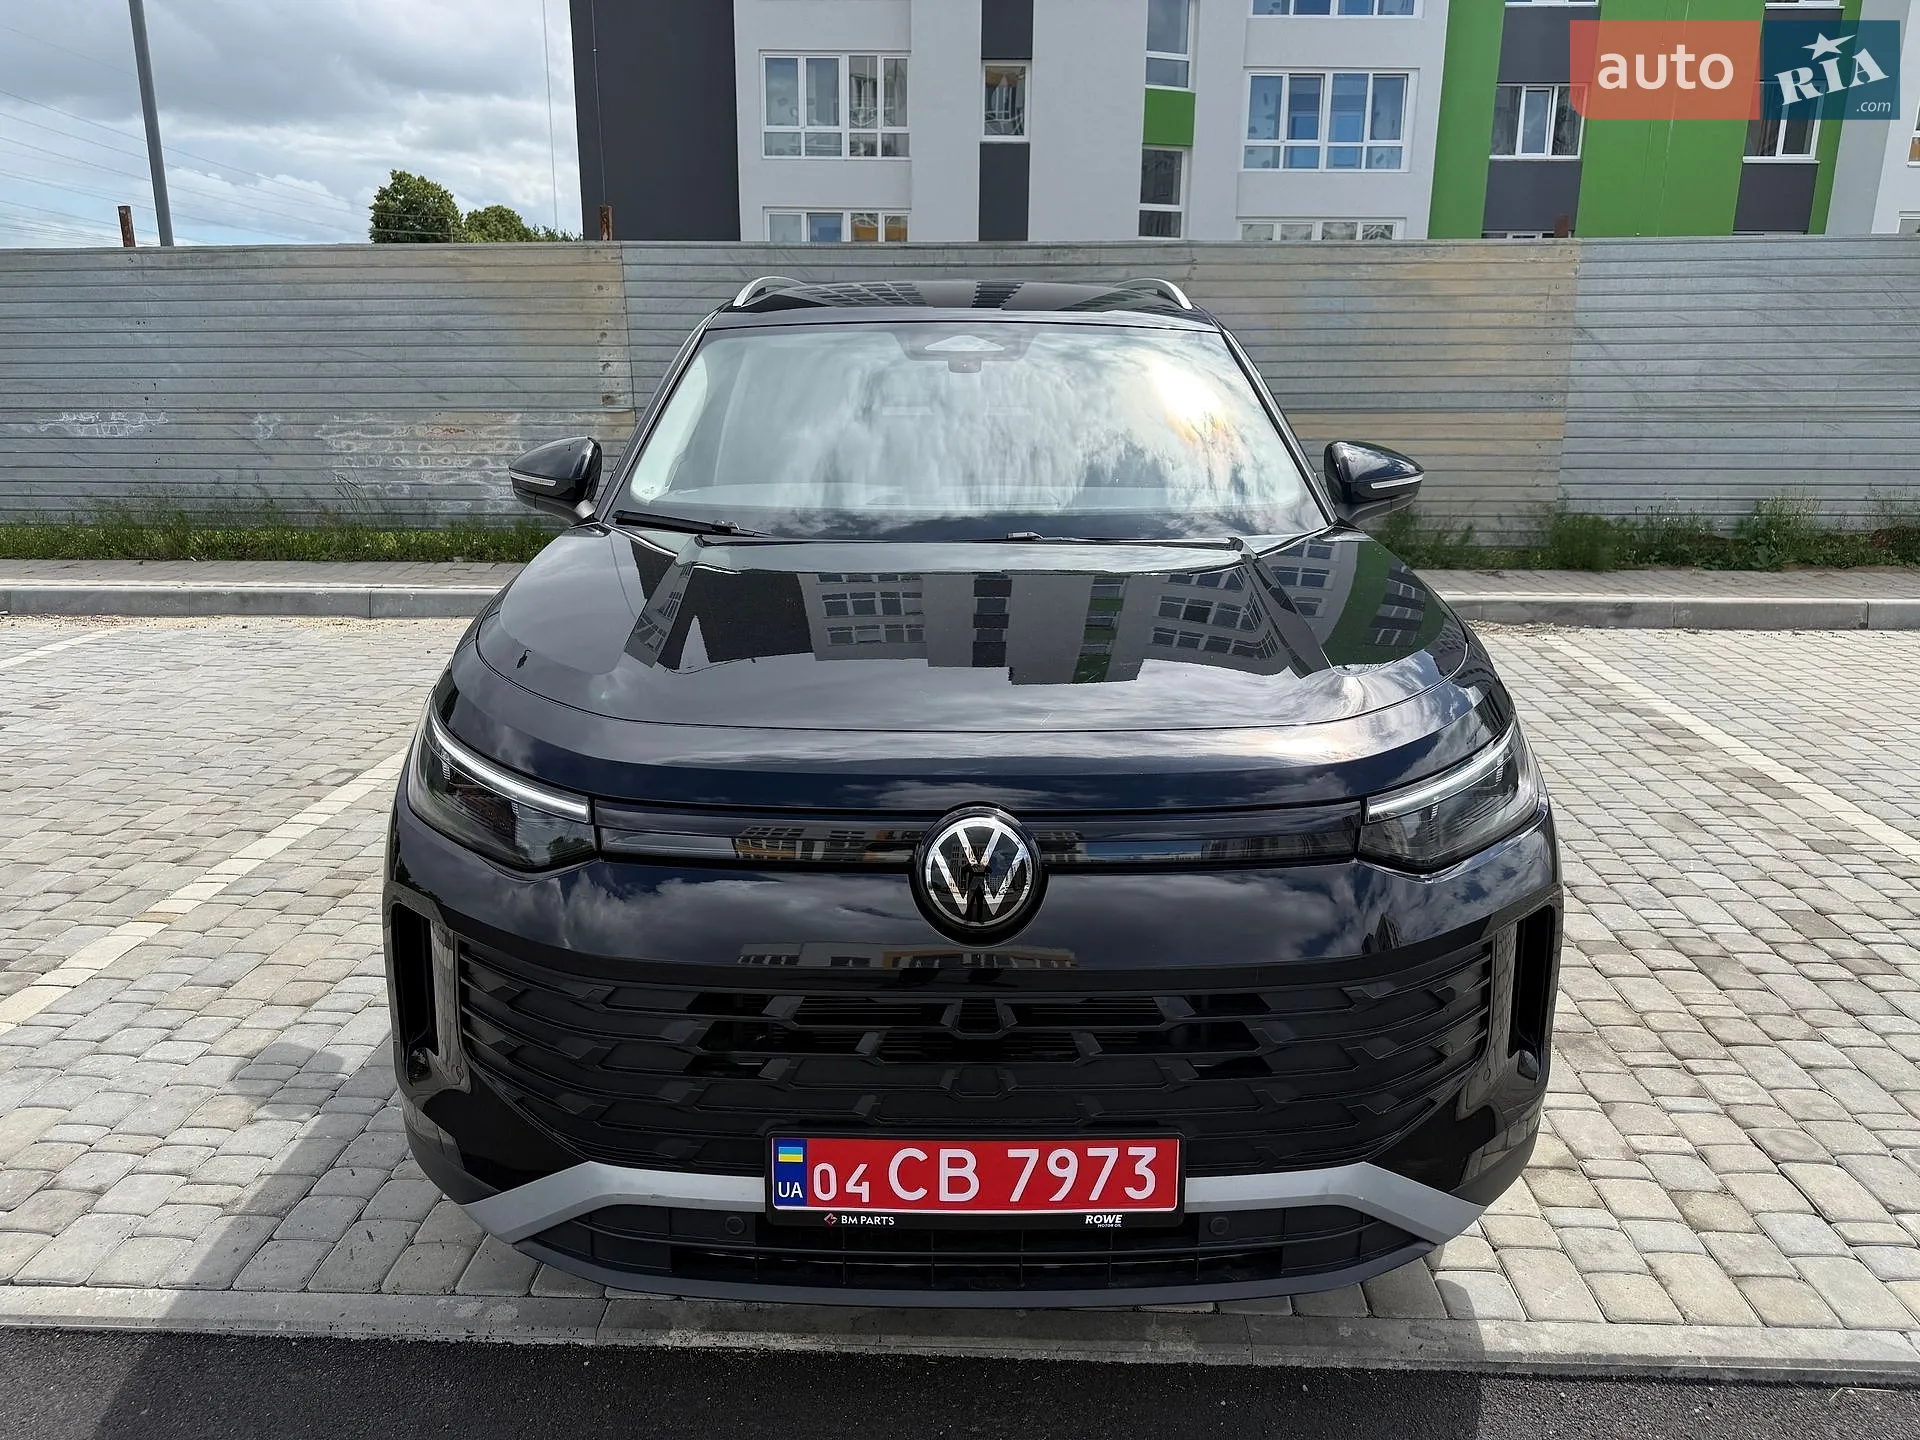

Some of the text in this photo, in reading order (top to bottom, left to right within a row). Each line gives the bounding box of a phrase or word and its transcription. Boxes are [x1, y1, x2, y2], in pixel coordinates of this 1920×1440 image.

[813, 1146, 1157, 1203] 04 CB 7973
[778, 1181, 803, 1198] UA
[841, 1215, 895, 1225] BM PARTS
[1085, 1214, 1122, 1224] ROWE
